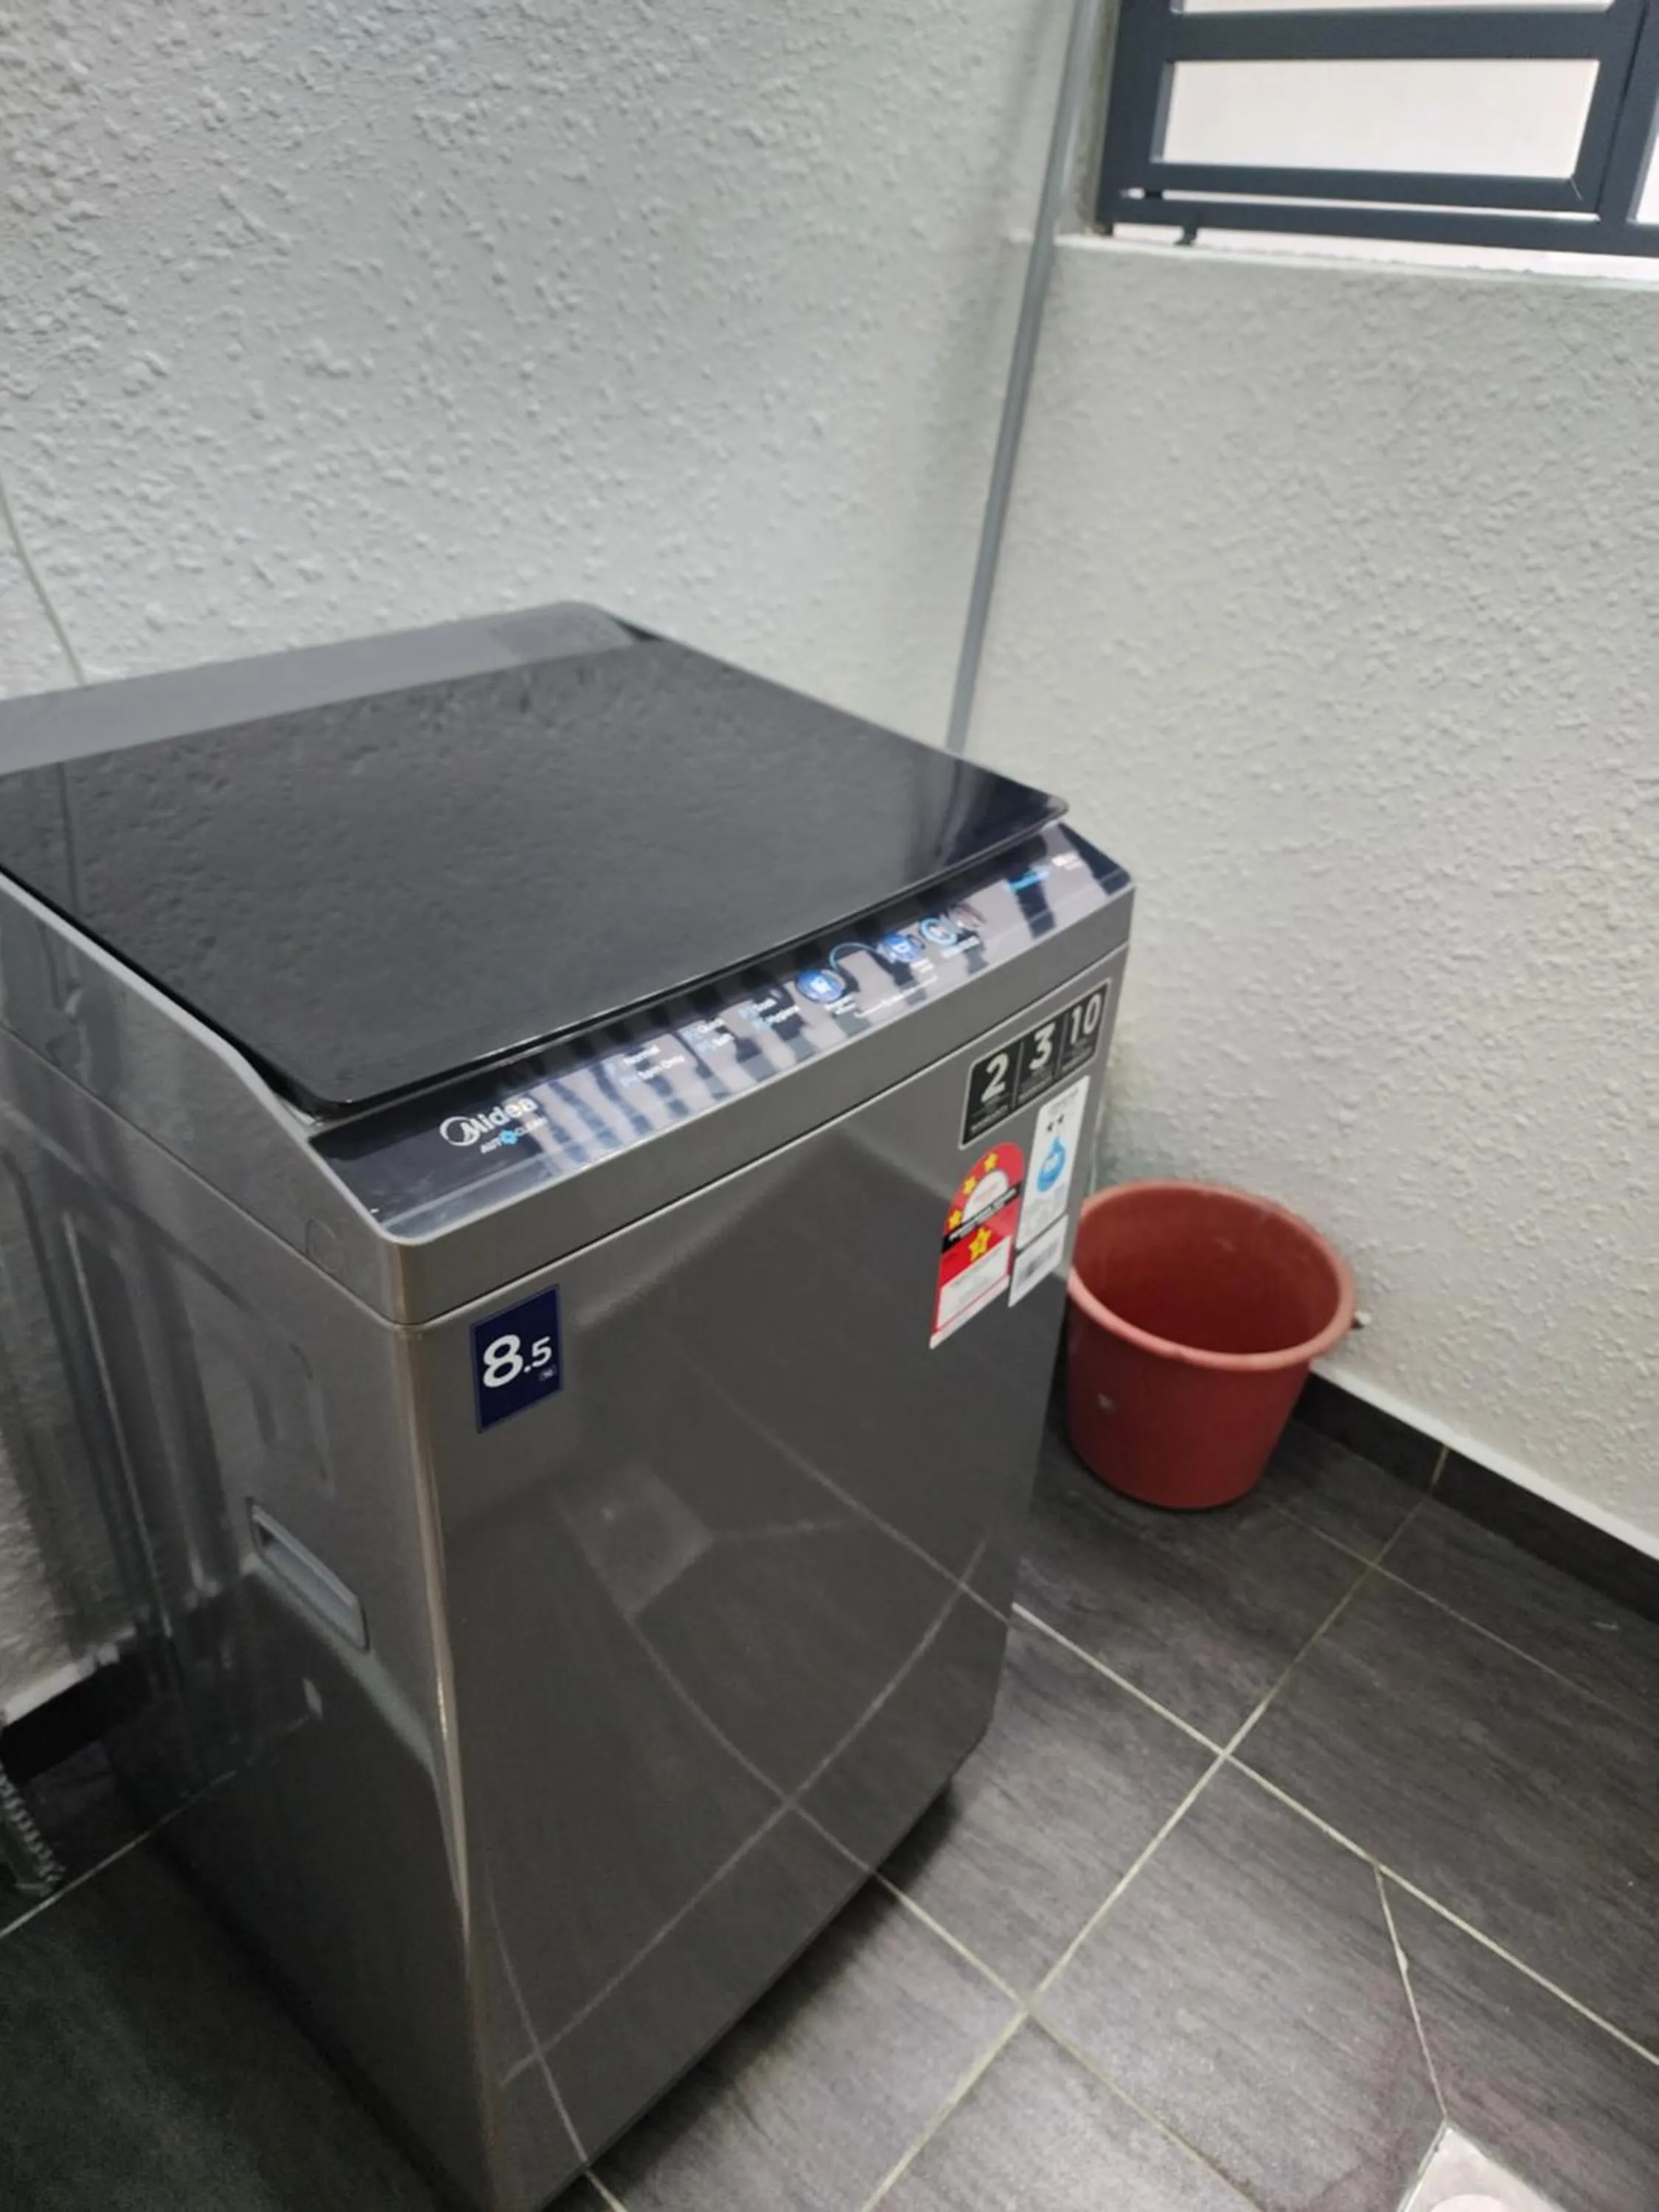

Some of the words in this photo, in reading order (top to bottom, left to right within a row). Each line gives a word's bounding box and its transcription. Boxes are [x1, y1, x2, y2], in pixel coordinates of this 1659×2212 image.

[1071, 994, 1102, 1045] 10
[1029, 1023, 1056, 1070] 3
[981, 1053, 1009, 1103] 2
[483, 1334, 552, 1388] 8.5
